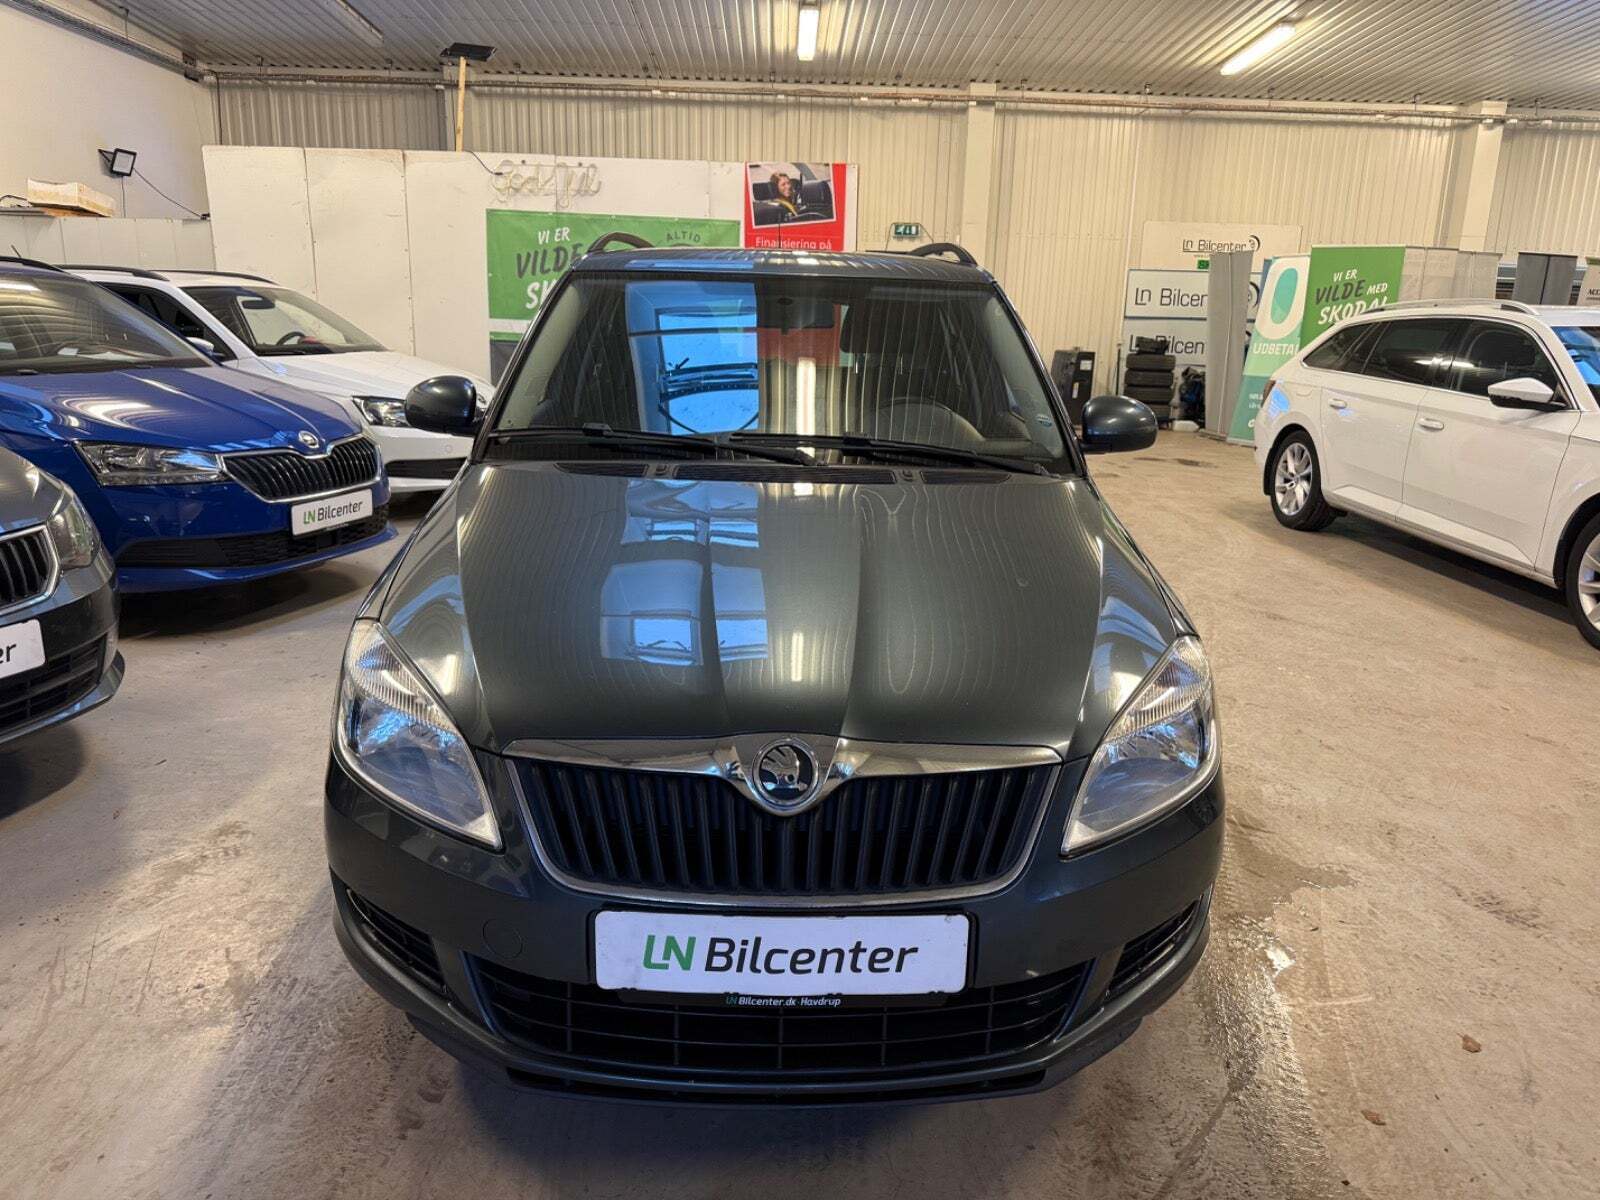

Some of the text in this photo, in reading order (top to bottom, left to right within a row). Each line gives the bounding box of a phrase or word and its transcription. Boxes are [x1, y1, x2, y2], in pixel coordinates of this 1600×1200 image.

[538, 227, 570, 245] VI ER
[666, 231, 701, 243] ALTID
[1333, 269, 1358, 282] VI ER
[1316, 280, 1388, 305] VILDE MED
[303, 501, 363, 525] LN Bilcenter
[642, 934, 919, 974] LN Bilcenter
